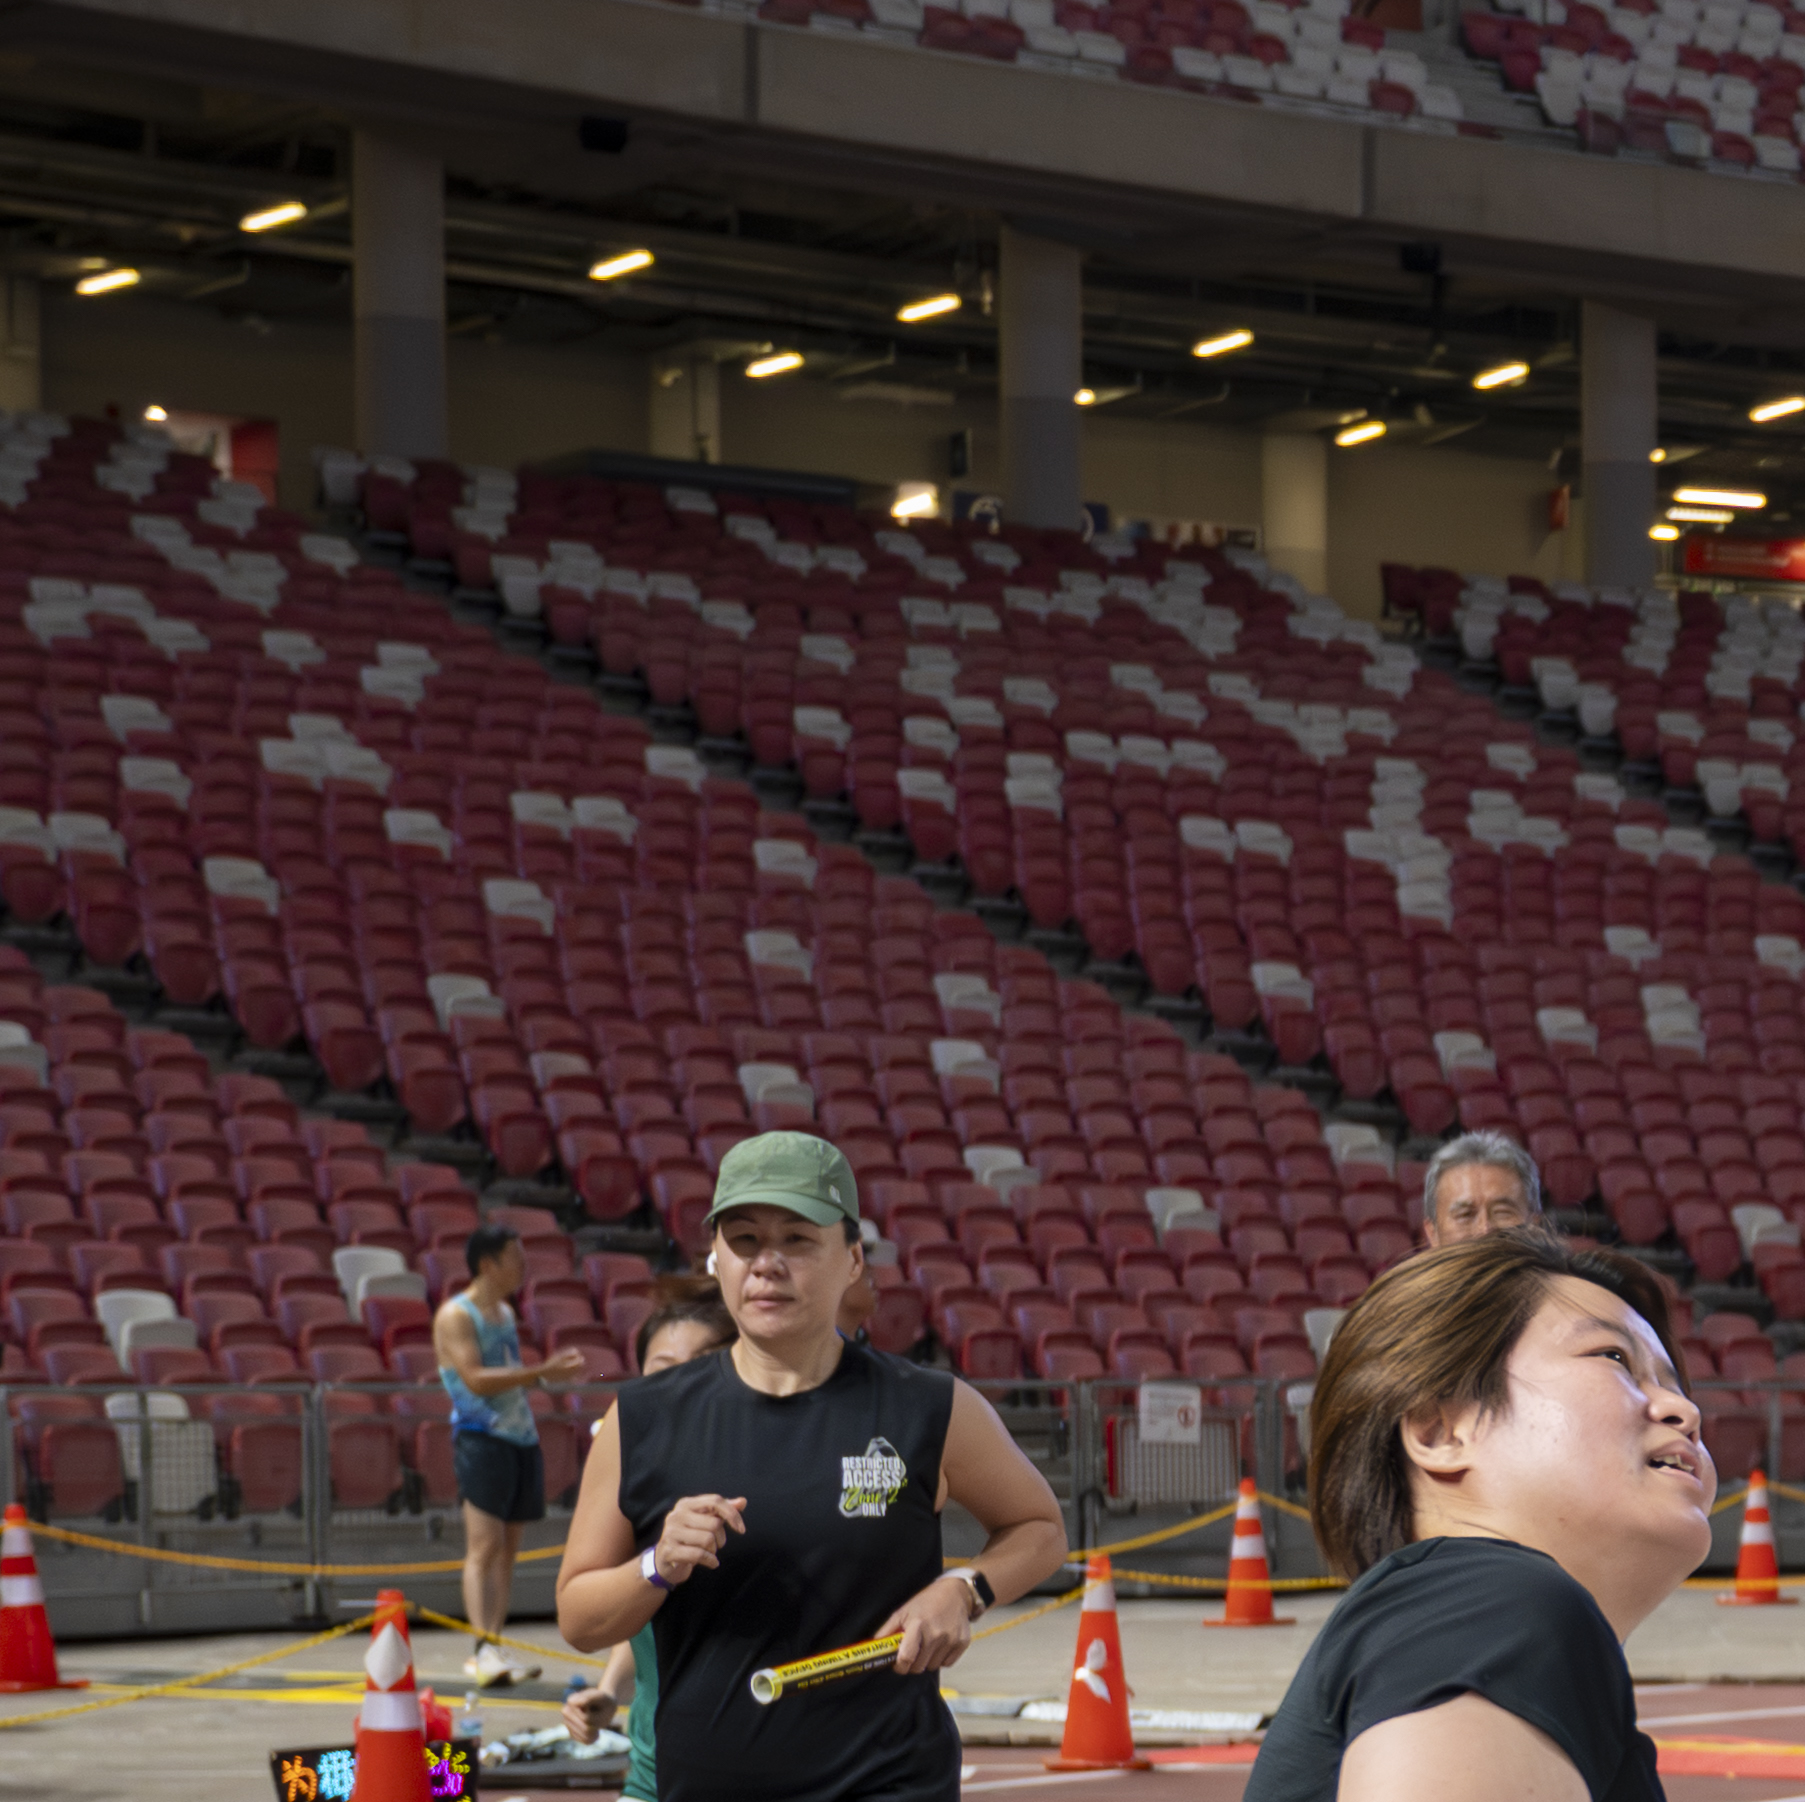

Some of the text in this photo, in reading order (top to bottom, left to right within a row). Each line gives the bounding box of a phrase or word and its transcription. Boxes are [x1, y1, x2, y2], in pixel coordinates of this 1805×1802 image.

[842, 1456, 900, 1470] RESTRICTED
[843, 1470, 901, 1489] ACCESS
[862, 1502, 887, 1517] ONLY
